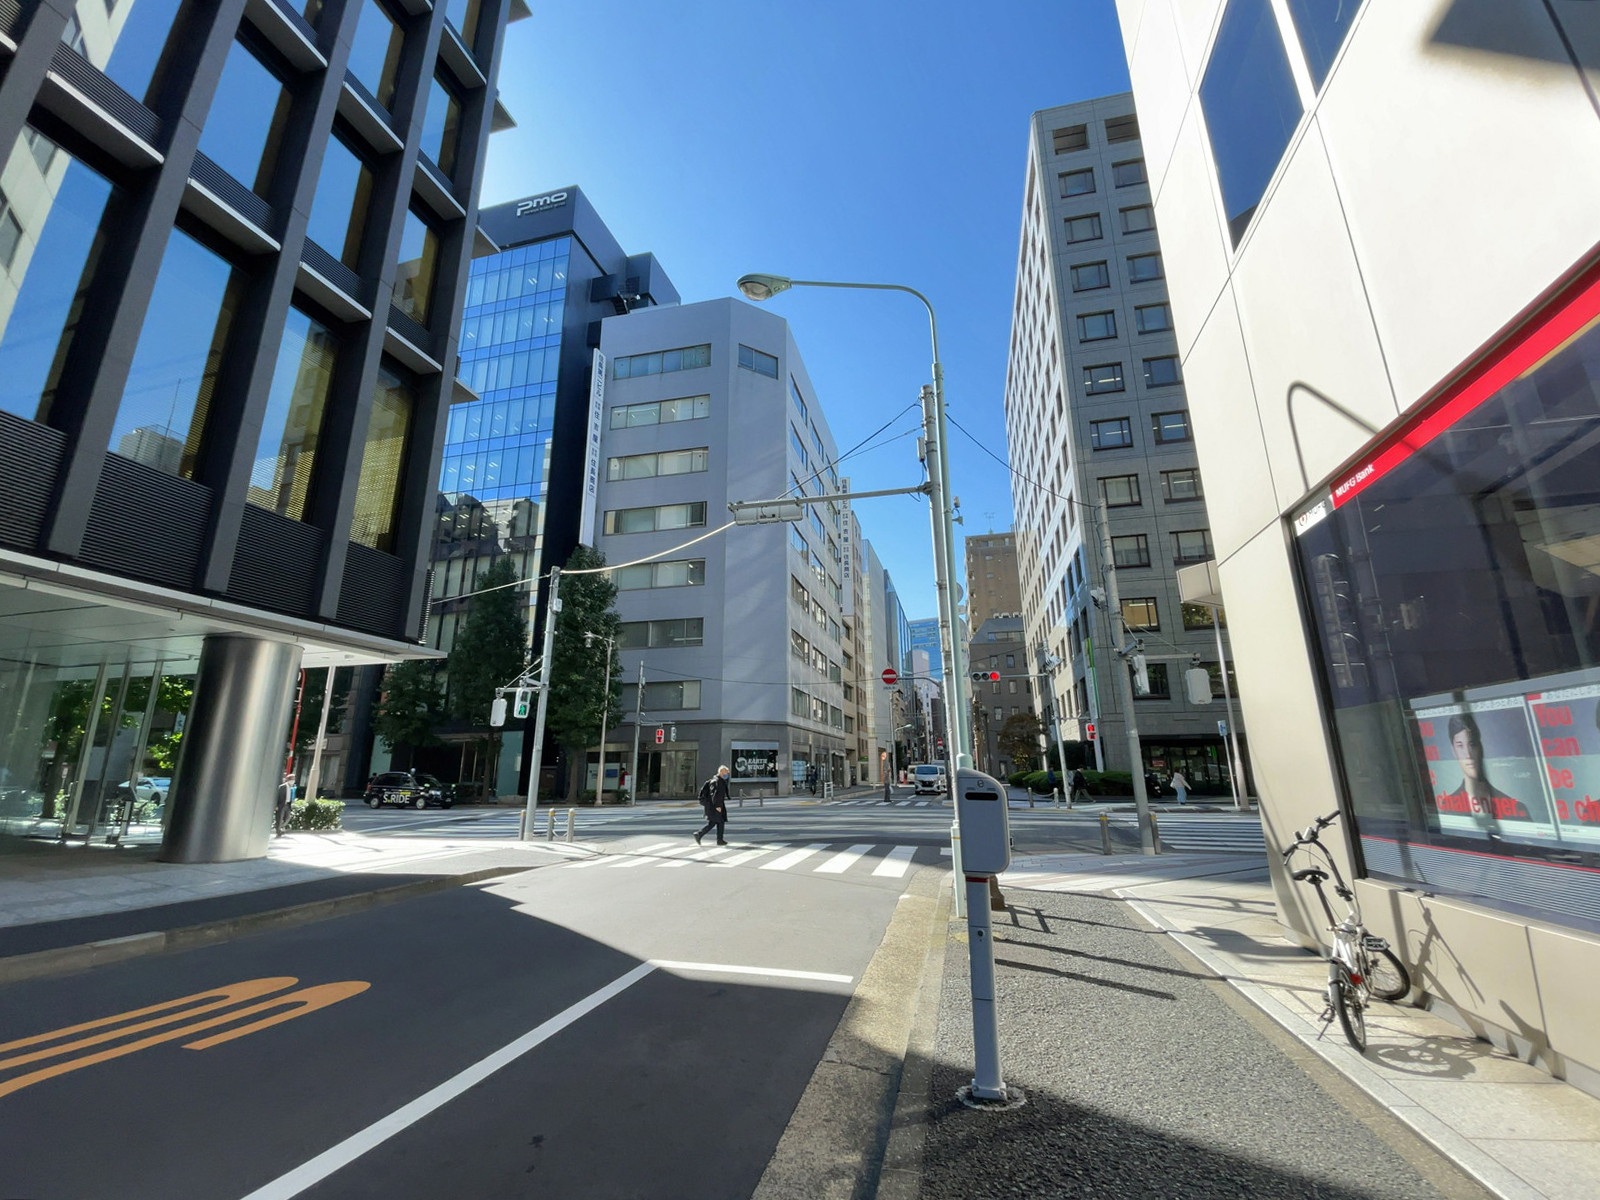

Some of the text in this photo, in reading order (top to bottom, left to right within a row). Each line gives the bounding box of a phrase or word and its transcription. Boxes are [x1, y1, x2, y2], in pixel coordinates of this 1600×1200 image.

[1335, 464, 1375, 497] MUFG Bank
[1532, 703, 1573, 727] You
[1541, 737, 1581, 758] can
[1546, 762, 1575, 789] be
[1555, 799, 1570, 820] a
